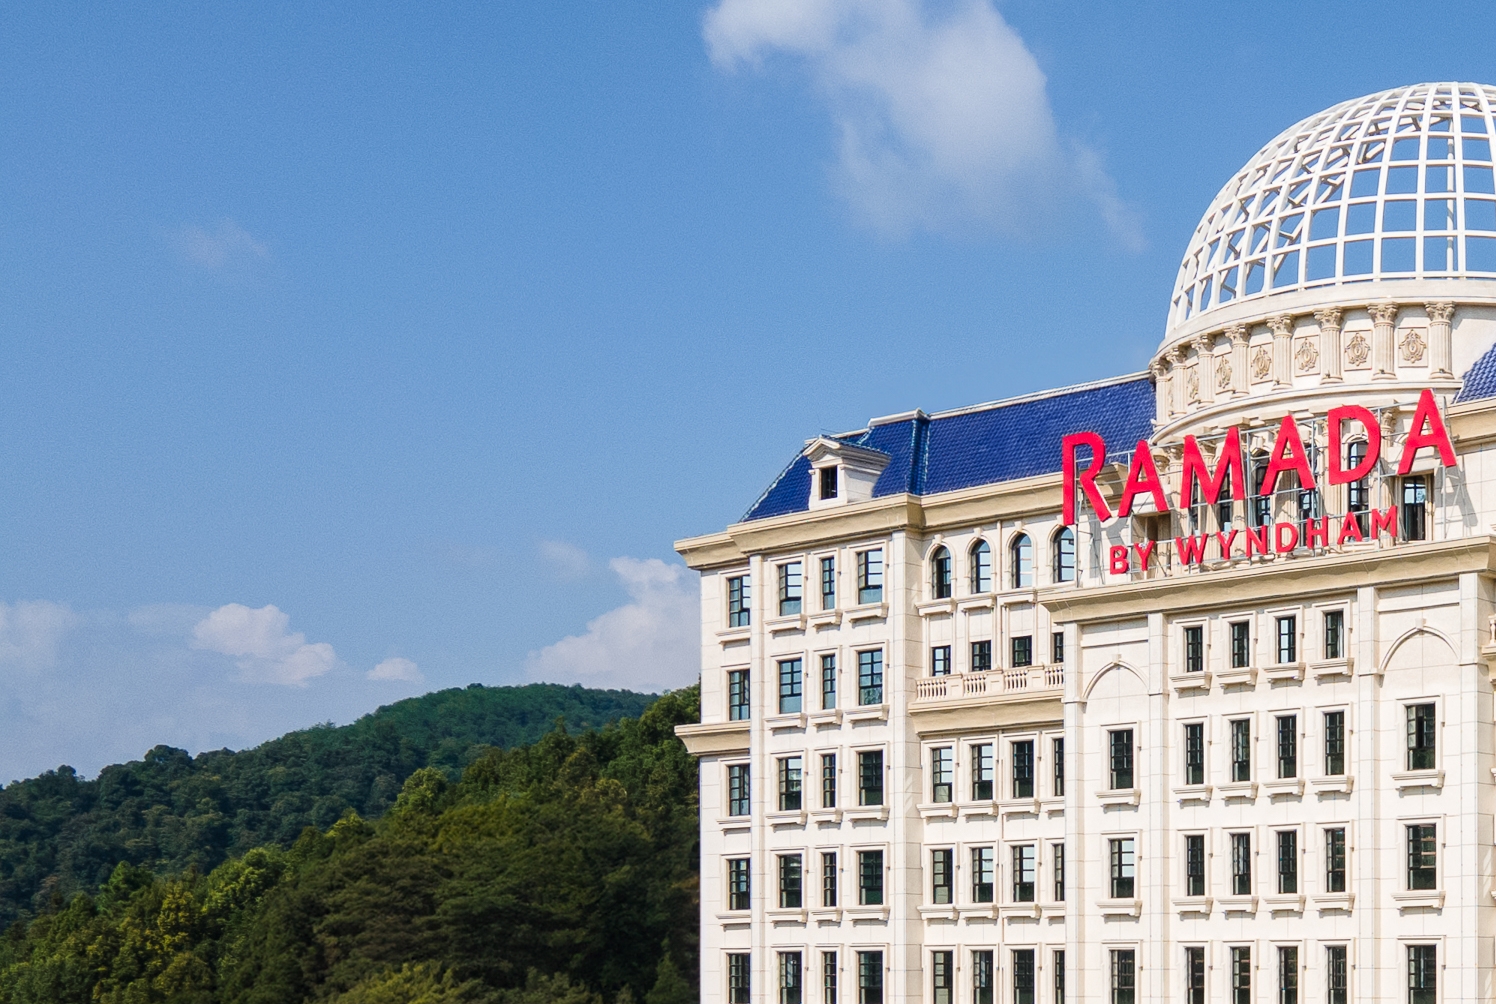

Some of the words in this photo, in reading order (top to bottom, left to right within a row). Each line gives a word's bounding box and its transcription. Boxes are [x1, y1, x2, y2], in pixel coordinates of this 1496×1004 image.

[1061, 388, 1457, 526] RAMADA
[1109, 539, 1156, 575] BY
[1175, 504, 1398, 567] WYNDHAM
